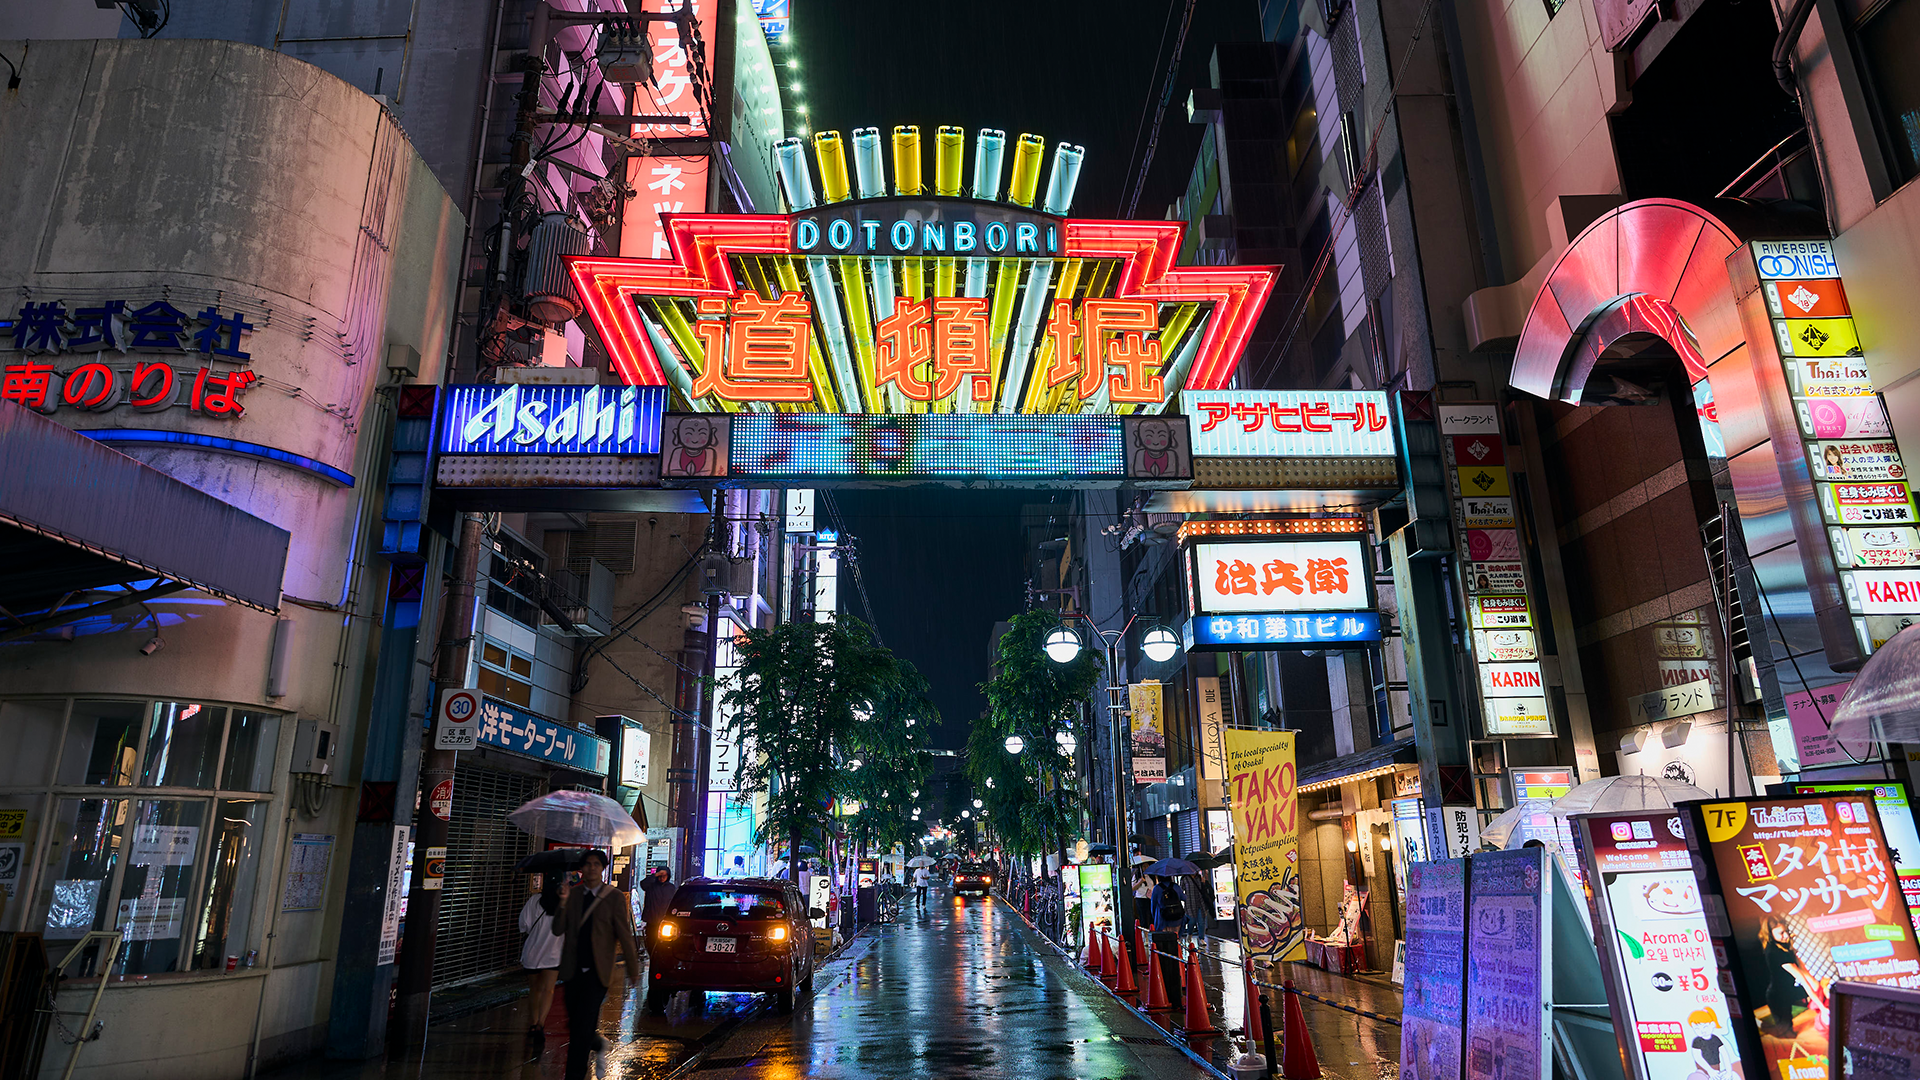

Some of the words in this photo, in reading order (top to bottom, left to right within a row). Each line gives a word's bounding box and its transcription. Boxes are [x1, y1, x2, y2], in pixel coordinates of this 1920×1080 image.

[797, 218, 1057, 253] DOTONBORI
[1762, 243, 1828, 254] RIVERSIDE
[1766, 283, 1782, 314] 9
[13, 300, 254, 362] 株式会社
[1777, 322, 1792, 353] 8
[692, 291, 1164, 402] 道頓堀
[1786, 361, 1800, 393] 7
[1, 361, 257, 419] 南のりば
[464, 383, 636, 445] Asahi
[1197, 402, 1387, 433] アサヒビール
[1445, 415, 1494, 425] パークランド
[1798, 402, 1814, 434] 6
[1839, 443, 1898, 455] 出会い喫茶
[1808, 444, 1826, 477] 5
[1838, 485, 1905, 498] 全身もみほぐし
[1824, 487, 1838, 520] 4
[1862, 508, 1908, 520] こり道楽
[1831, 529, 1849, 565] 3
[1861, 549, 1907, 557] アロマオイル
[1869, 557, 1906, 566] マッサージ
[1215, 557, 1349, 596] 治兵衛
[1843, 574, 1861, 610] 2
[1482, 598, 1526, 607] 全身もみほぐし
[1497, 614, 1527, 624] こり道楽
[1491, 672, 1541, 687] KARIN
[1205, 689, 1216, 703] DUE
[1637, 687, 1704, 716] パークランド
[1793, 693, 1837, 711] テナント募集
[452, 700, 470, 715] 30
[441, 736, 472, 744] ここから
[1231, 750, 1243, 760] The
[1234, 762, 1242, 771] of
[1242, 756, 1264, 769] Osaka!
[1232, 761, 1295, 810] TAKO
[1245, 798, 1297, 844] YAKI
[1709, 810, 1737, 828] 7F
[1454, 810, 1470, 857] 防犯カメ
[1242, 856, 1273, 870] 大阪名物
[1605, 853, 1650, 862] Welcome
[1746, 848, 1768, 877] 本格
[1773, 838, 1886, 878] タイ古式
[1240, 866, 1280, 882] たこ焼き
[1735, 871, 1890, 915] マッサージ
[1420, 896, 1447, 916] こり道楽
[1642, 931, 1689, 945] Aroma
[712, 943, 735, 952] 30-27
[1646, 948, 1669, 962] 오일
[1673, 946, 1706, 960] 마사지
[1836, 962, 1857, 977] Thai
[1789, 1064, 1826, 1079] Aroma
